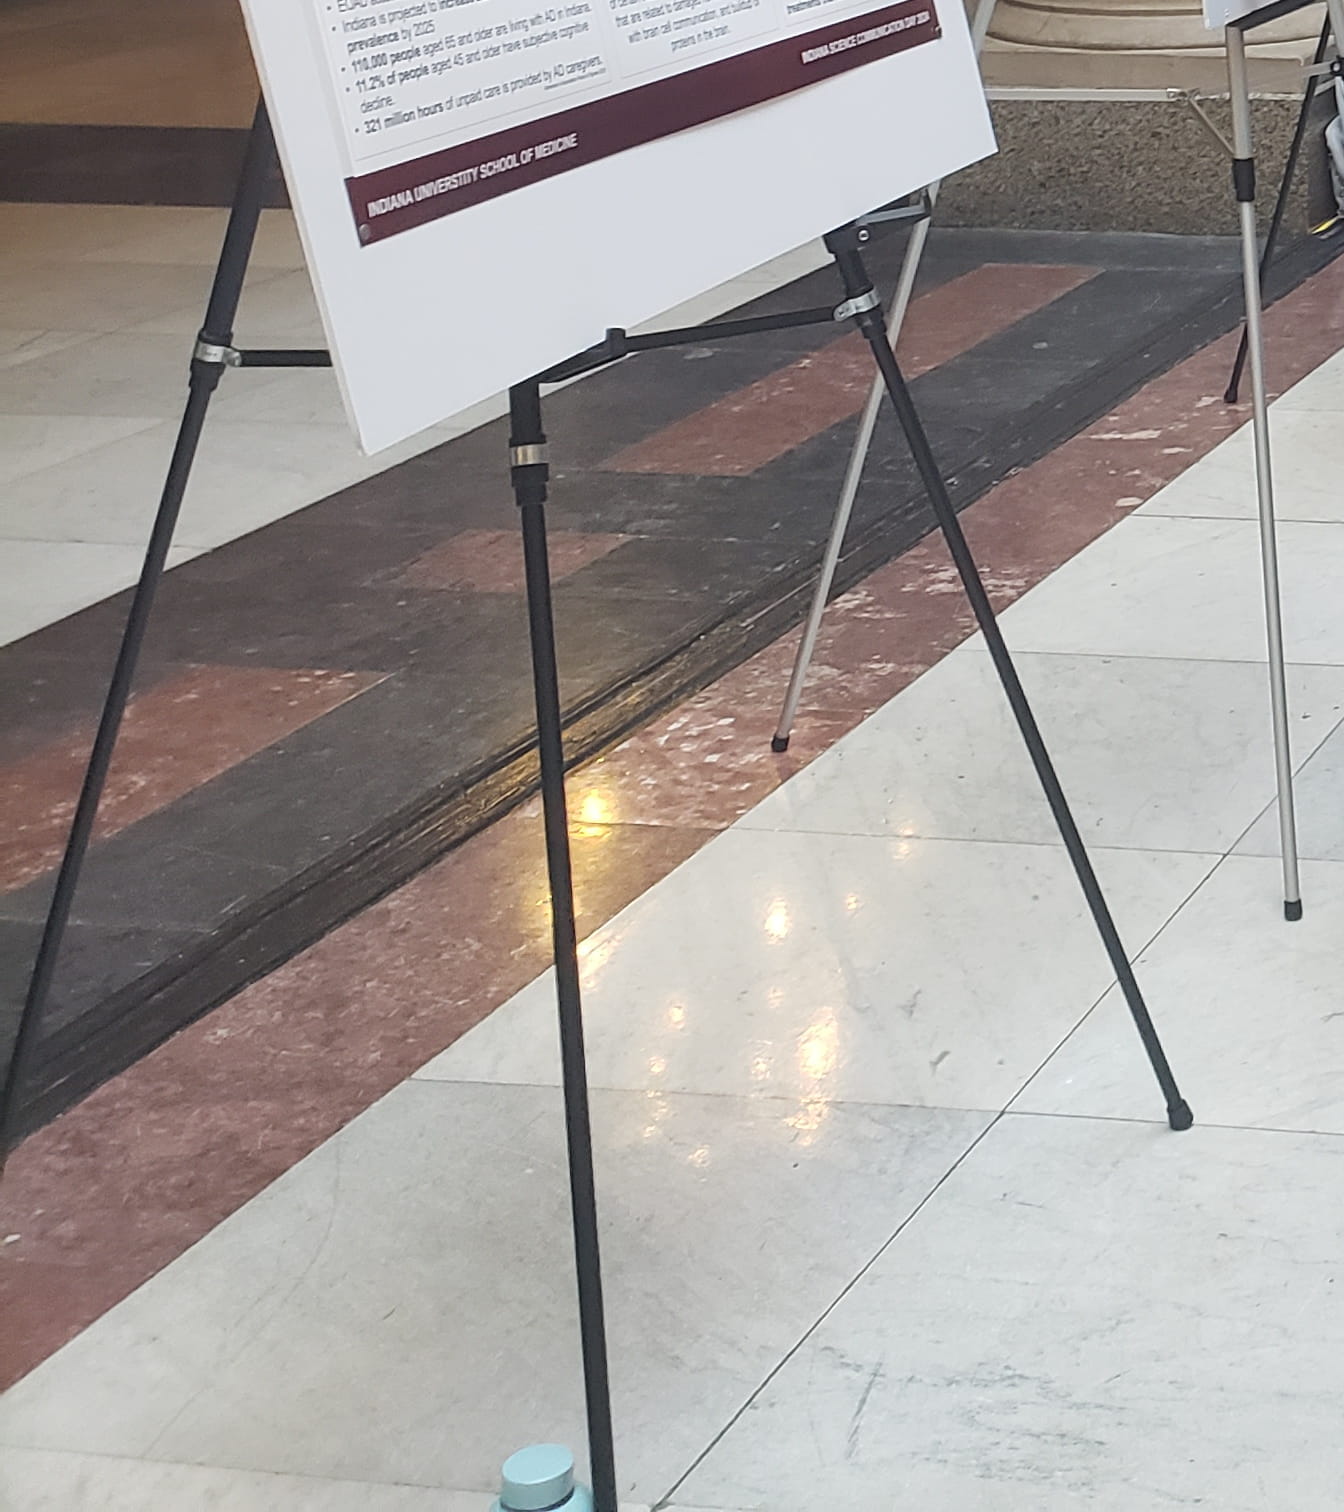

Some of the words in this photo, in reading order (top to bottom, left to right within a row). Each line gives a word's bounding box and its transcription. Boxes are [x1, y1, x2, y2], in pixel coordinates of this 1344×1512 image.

[341, 13, 377, 33] Indiana
[346, 29, 400, 56] prevalence
[389, 44, 421, 67] people
[397, 63, 430, 86] people
[416, 100, 444, 118] hours
[366, 188, 414, 218] INDIANA
[478, 153, 520, 179] SCHOOL
[519, 148, 535, 165] OF
[533, 133, 578, 160] MEDICINE
